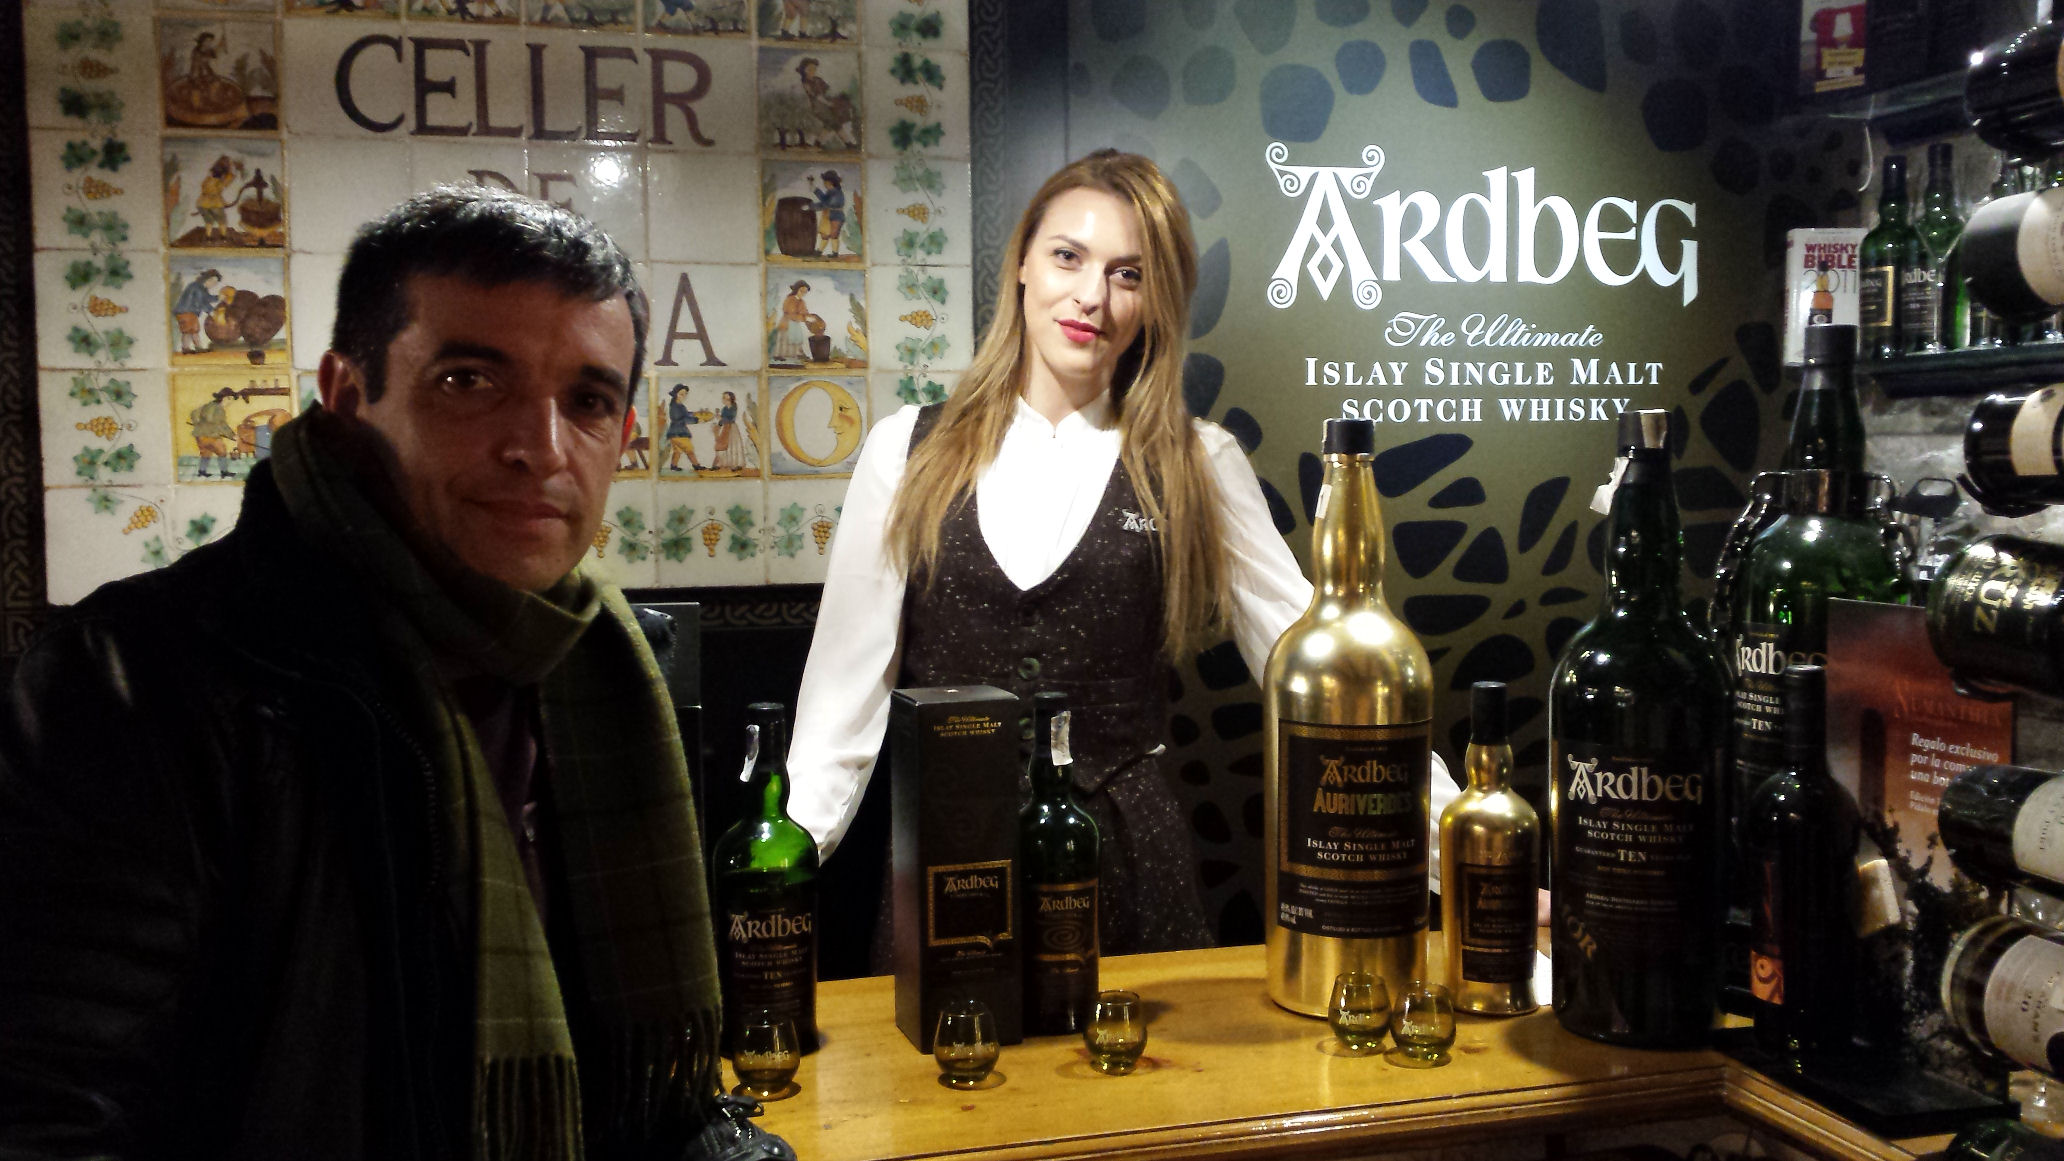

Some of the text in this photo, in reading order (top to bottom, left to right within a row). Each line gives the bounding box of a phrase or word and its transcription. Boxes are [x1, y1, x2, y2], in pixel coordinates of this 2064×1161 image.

[335, 33, 715, 147] CELLER
[1266, 141, 1698, 310] Ardbeg
[1805, 243, 1858, 254] WHISKY
[1804, 253, 1857, 269] BIBLE
[1385, 311, 1603, 348] The Ultimate
[1305, 357, 1663, 386] ISLAY SINGLE MALT
[1341, 398, 1630, 423] SCOTCH WHISKY
[1911, 732, 1999, 763] Regalo exclusivo
[1910, 753, 1929, 766] por
[1931, 753, 1941, 768] la
[1319, 754, 1409, 787] Ardbeg
[1567, 753, 1702, 805] Ardbeg
[1910, 770, 1930, 782] una
[1578, 816, 1607, 829] ISLAY
[1612, 821, 1656, 832] SINGLE
[1307, 837, 1338, 850] ISLAY
[1343, 840, 1385, 851] SINGLE
[1587, 829, 1684, 844] SCOTCH WHISKY
[1317, 851, 1408, 862] SCOTCH WHISKY
[1618, 849, 1648, 862] TEN
[944, 875, 998, 893] Ardbeg
[728, 910, 813, 943] Ardbeg
